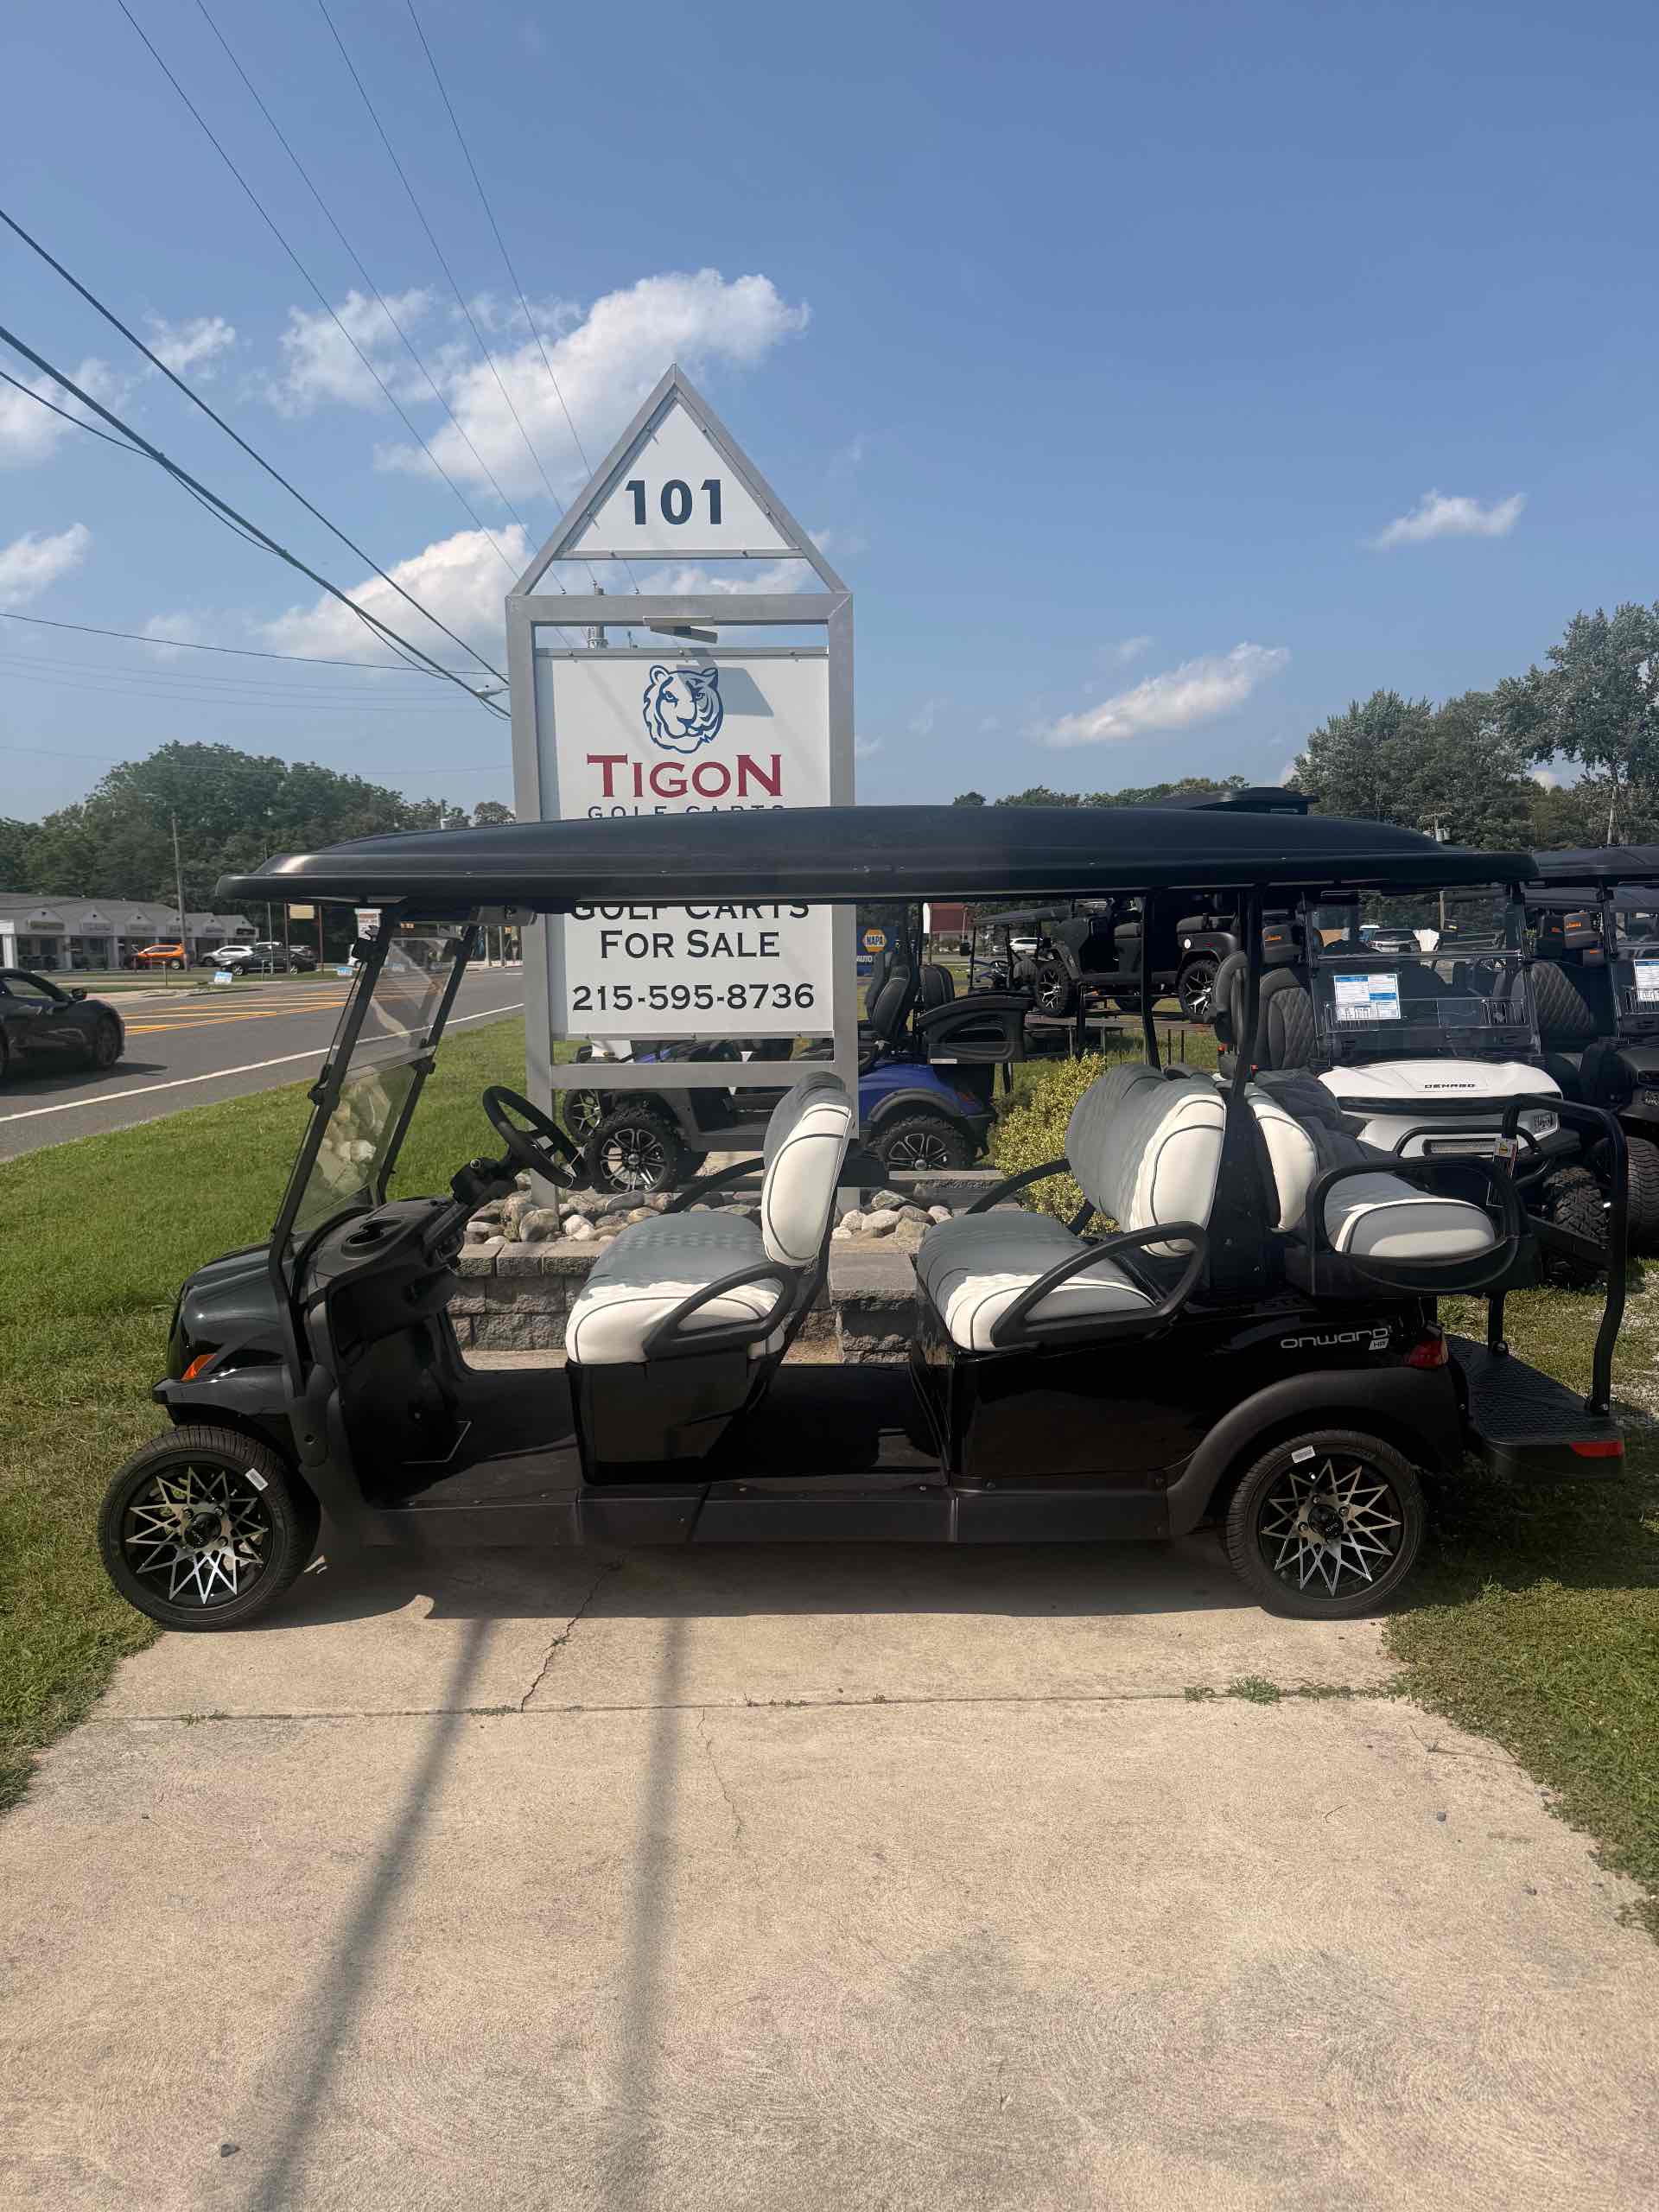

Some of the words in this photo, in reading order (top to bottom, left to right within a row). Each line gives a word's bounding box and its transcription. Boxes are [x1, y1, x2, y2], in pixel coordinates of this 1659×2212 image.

[625, 479, 721, 525] 101
[587, 753, 783, 798] TIGON
[588, 805, 667, 818] GOLF
[601, 930, 674, 958] FOR
[686, 929, 780, 958] SALE
[573, 983, 815, 1011] 215-595-8736
